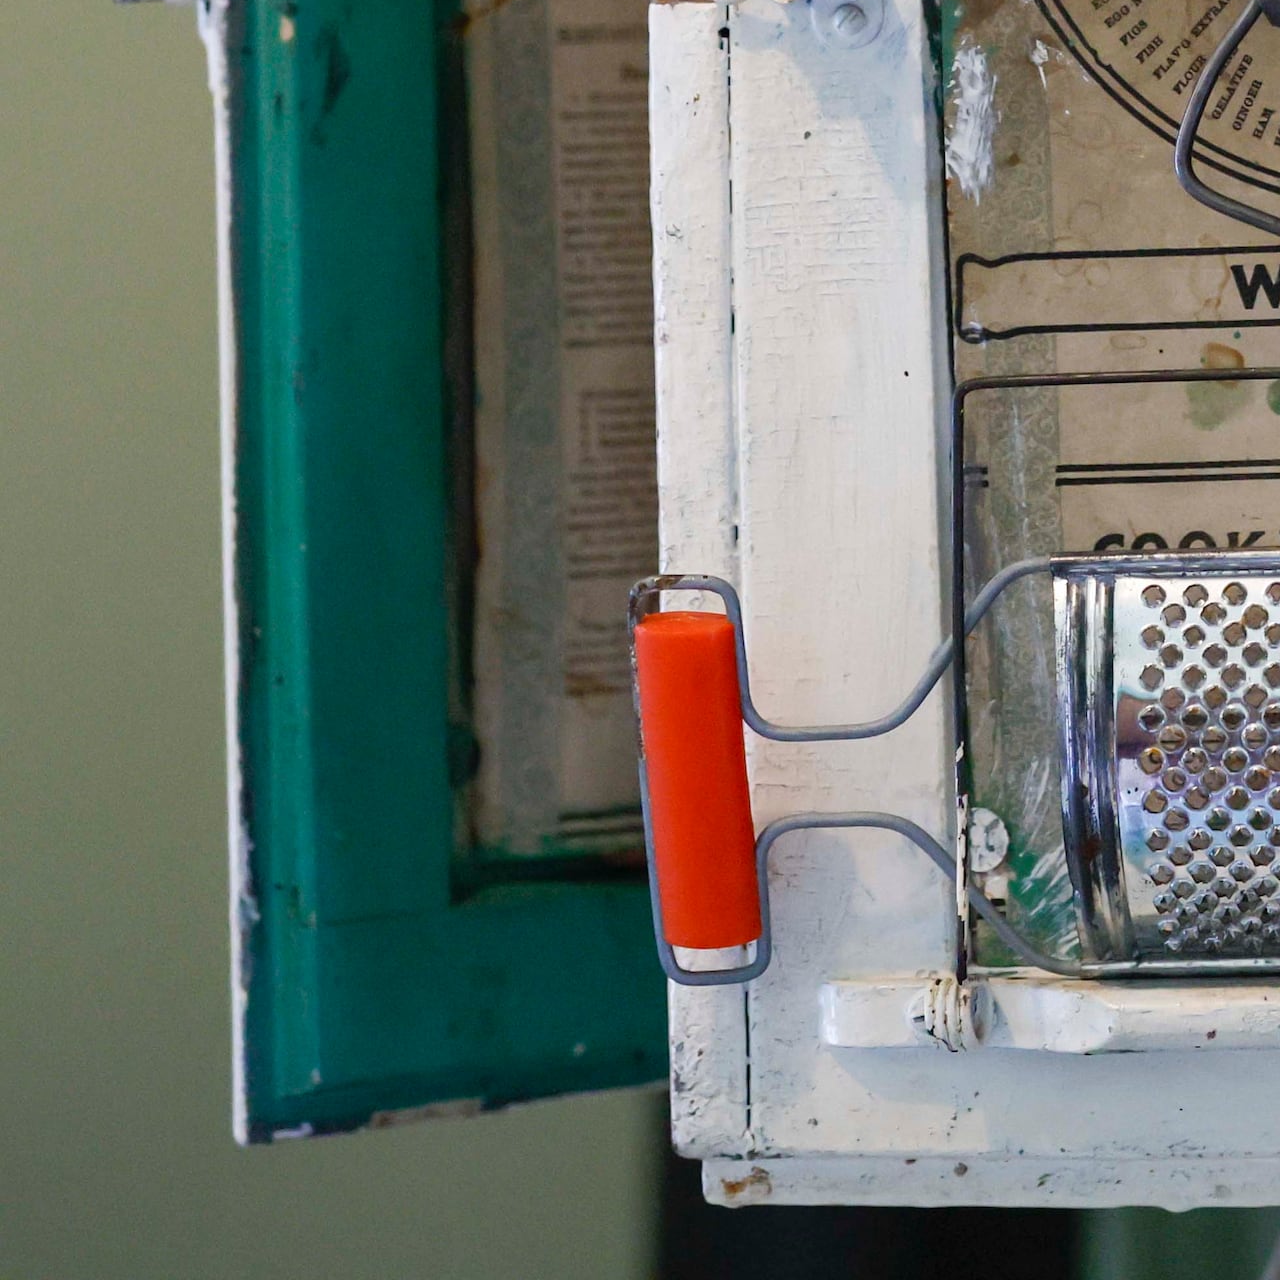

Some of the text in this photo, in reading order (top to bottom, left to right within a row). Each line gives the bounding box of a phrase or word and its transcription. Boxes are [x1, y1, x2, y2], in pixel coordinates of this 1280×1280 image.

[1104, 7, 1131, 29] EGG
[1119, 19, 1149, 47] FIGS
[1135, 36, 1164, 65] FISH
[1172, 55, 1208, 96] FLOUR
[1211, 54, 1254, 120] GELATINE
[1232, 79, 1263, 131] GINGER
[1252, 107, 1275, 140] HAM
